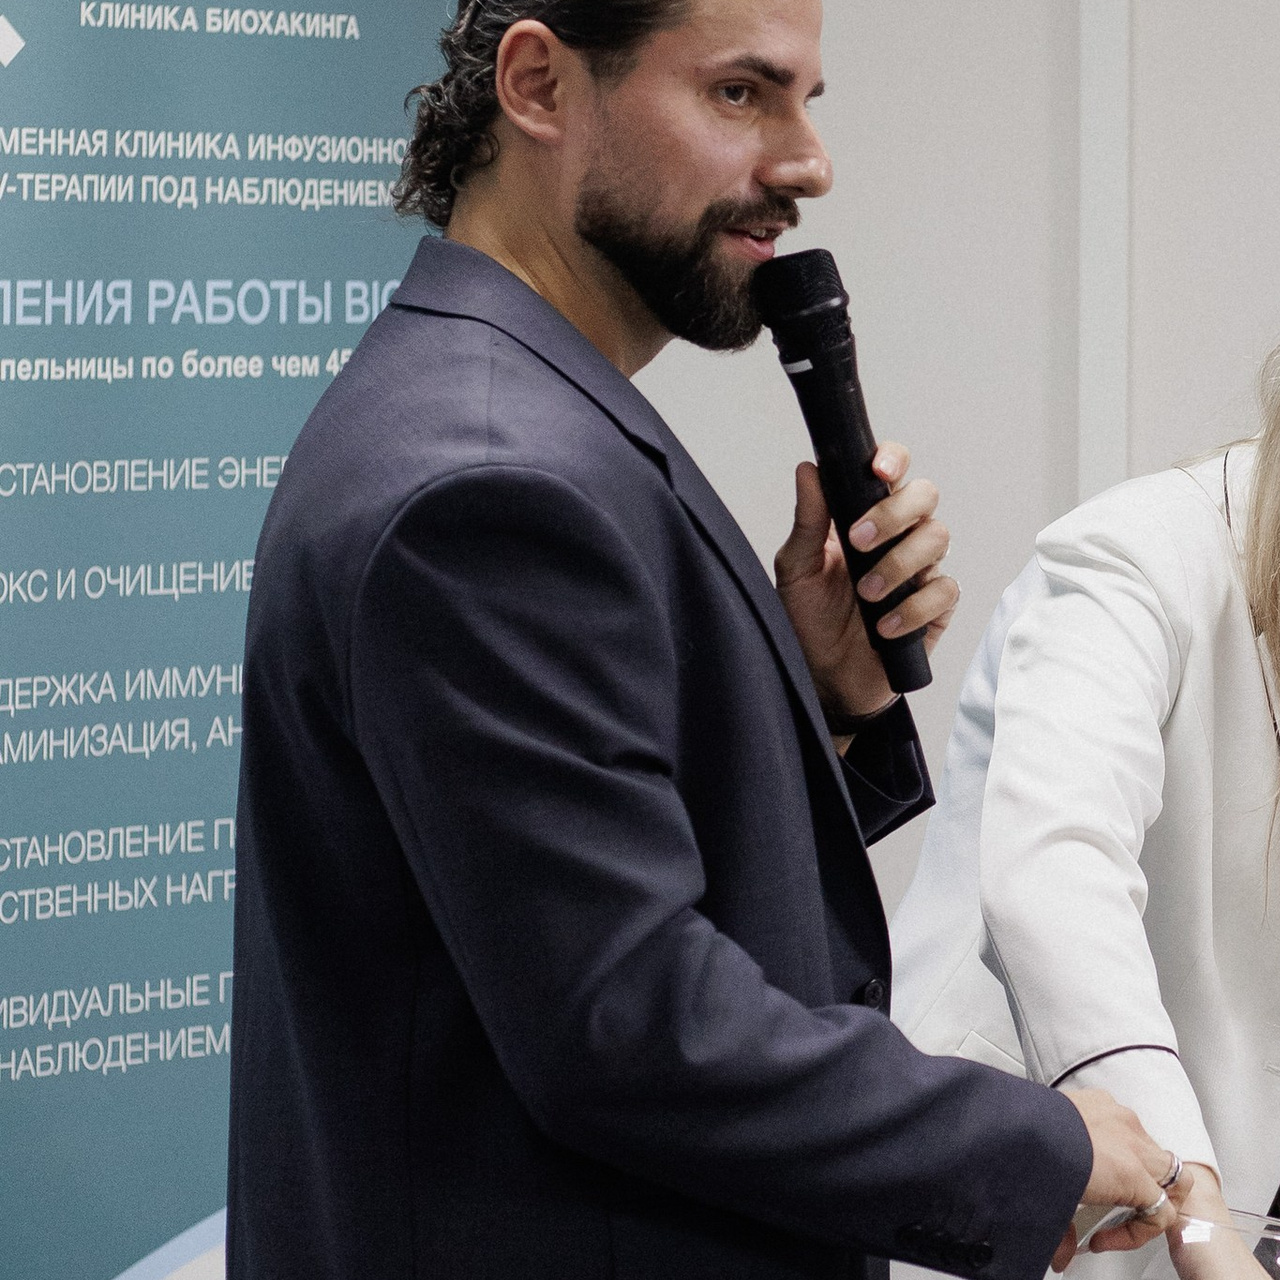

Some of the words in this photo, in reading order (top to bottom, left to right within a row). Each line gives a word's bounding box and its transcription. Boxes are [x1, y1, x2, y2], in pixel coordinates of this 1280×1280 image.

[81, 2, 198, 31] КЛИНИКА
[206, 8, 359, 39] БИОХАКИНГА
[0, 127, 107, 156] МЕННАЯ
[115, 131, 240, 159] КЛИНИКА
[142, 176, 198, 209] ПОД
[148, 279, 331, 324] РАБОТЫ
[0, 357, 133, 383] пельницы
[142, 357, 174, 378] по
[182, 349, 263, 378] более
[272, 356, 319, 377] чем
[0, 458, 209, 496] СТАНОВЛЕНИЕ
[57, 568, 75, 600] И
[85, 560, 254, 601] ОЧИЩЕНИЕ
[0, 672, 116, 717] ДЕРЖКА
[126, 664, 242, 701] ИММУН
[0, 719, 196, 764] МИНИЗАЦИЯ,
[214, 818, 234, 849] П
[0, 877, 157, 923] СТВЕННЫХ
